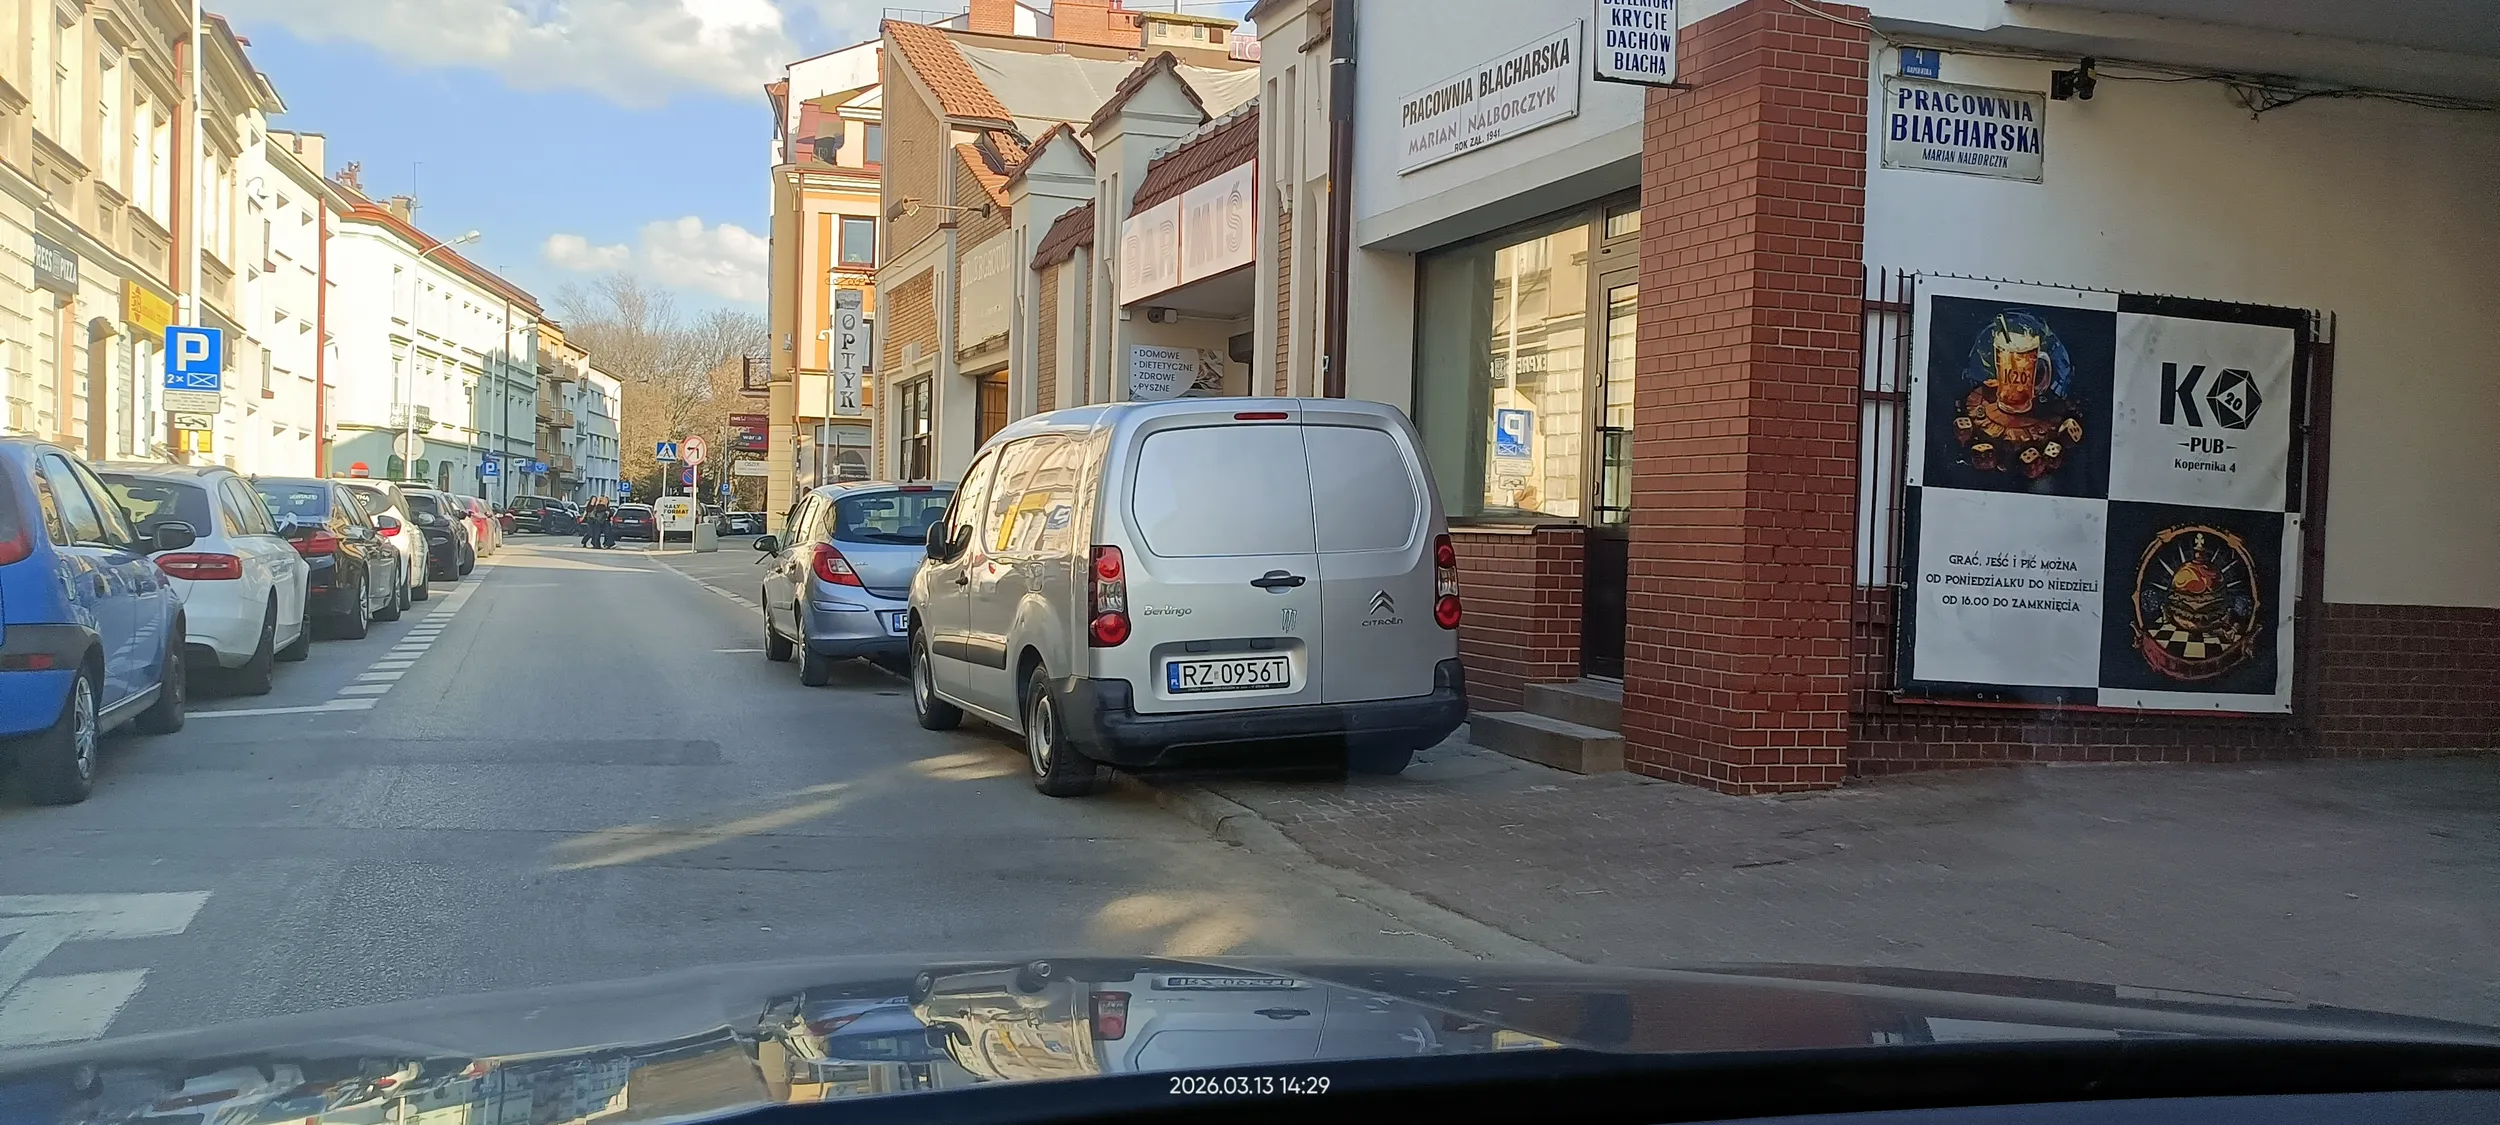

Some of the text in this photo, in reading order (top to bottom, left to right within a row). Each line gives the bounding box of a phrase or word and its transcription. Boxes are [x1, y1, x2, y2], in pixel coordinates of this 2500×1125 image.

[1611, 8, 1667, 31] KRYCIE
[1607, 30, 1670, 52] DACHÓW
[1615, 52, 1666, 76] BLACHĄ
[1915, 49, 1923, 64] 4
[1402, 38, 1569, 128] PRACOWNIA BLACHARSKA
[1898, 88, 2034, 122] PRACOWNIA
[1408, 85, 1556, 155] MARIAN NALBORCZYK
[1454, 139, 1468, 152] ROK
[1486, 128, 1501, 142] 1941
[1891, 114, 2040, 154] BLACHARSKA
[1922, 148, 2009, 168] MARIAN NALBORCZYK
[1126, 181, 1243, 289] BAR MIŚ
[177, 332, 209, 371] P
[840, 313, 856, 408] OPTYK
[1140, 350, 1180, 359] DOMOWE
[1140, 361, 1193, 371] DIETETYCZNE
[1140, 372, 1175, 381] ZDROWE
[1139, 383, 1170, 392] PYSZNE
[2225, 392, 2242, 410] 20
[2190, 437, 2224, 453] PUB
[2174, 458, 2236, 473] Kopernika 4
[1949, 551, 1982, 567] GRAĆ,
[1986, 553, 2009, 567] JEŚĆ
[2020, 555, 2037, 569] PIĆ
[2040, 557, 2077, 571] MOŻNA
[1926, 574, 1941, 583] OD
[2028, 580, 2044, 589] DO
[2048, 577, 2099, 592] NIEDZIELI
[1144, 605, 1192, 617] Berlingo
[1942, 595, 2080, 613] OD 16.00 DO ZAMKNIĘCIA
[1183, 661, 1284, 686] RZ 0956T
